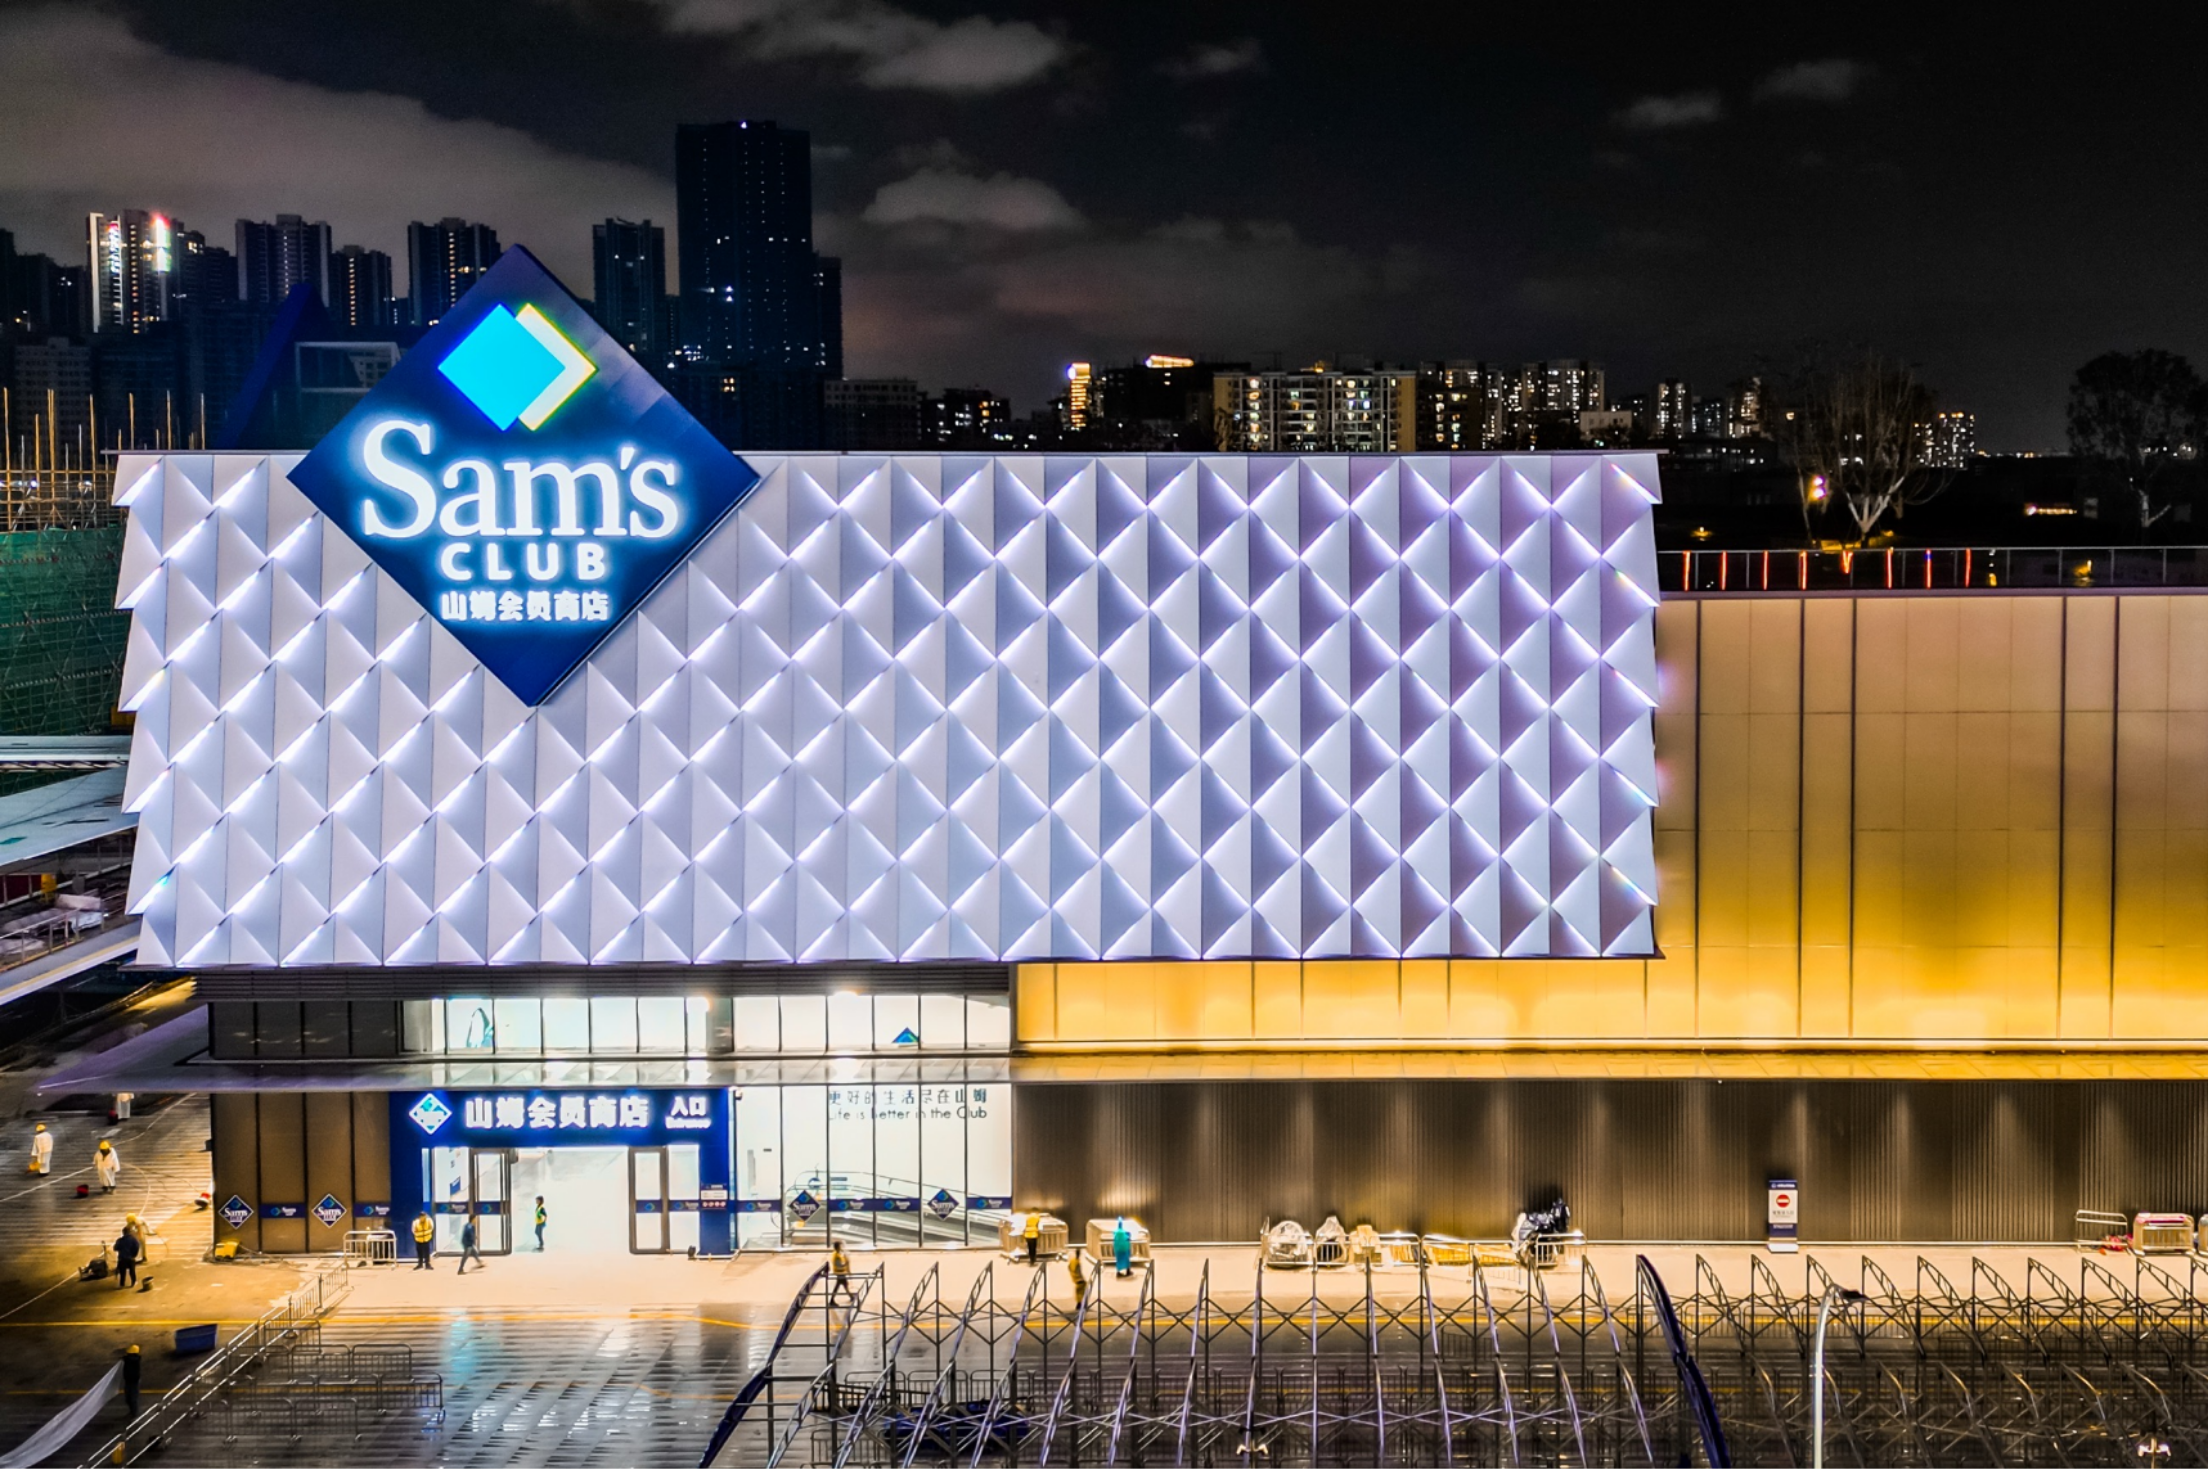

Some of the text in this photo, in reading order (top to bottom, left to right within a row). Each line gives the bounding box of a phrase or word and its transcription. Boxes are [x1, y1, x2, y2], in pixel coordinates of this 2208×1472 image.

[363, 418, 678, 538] Sam's
[441, 542, 606, 581] CLUB
[671, 1096, 707, 1116] 入口
[872, 1107, 910, 1120] etter
[931, 1107, 952, 1119] the
